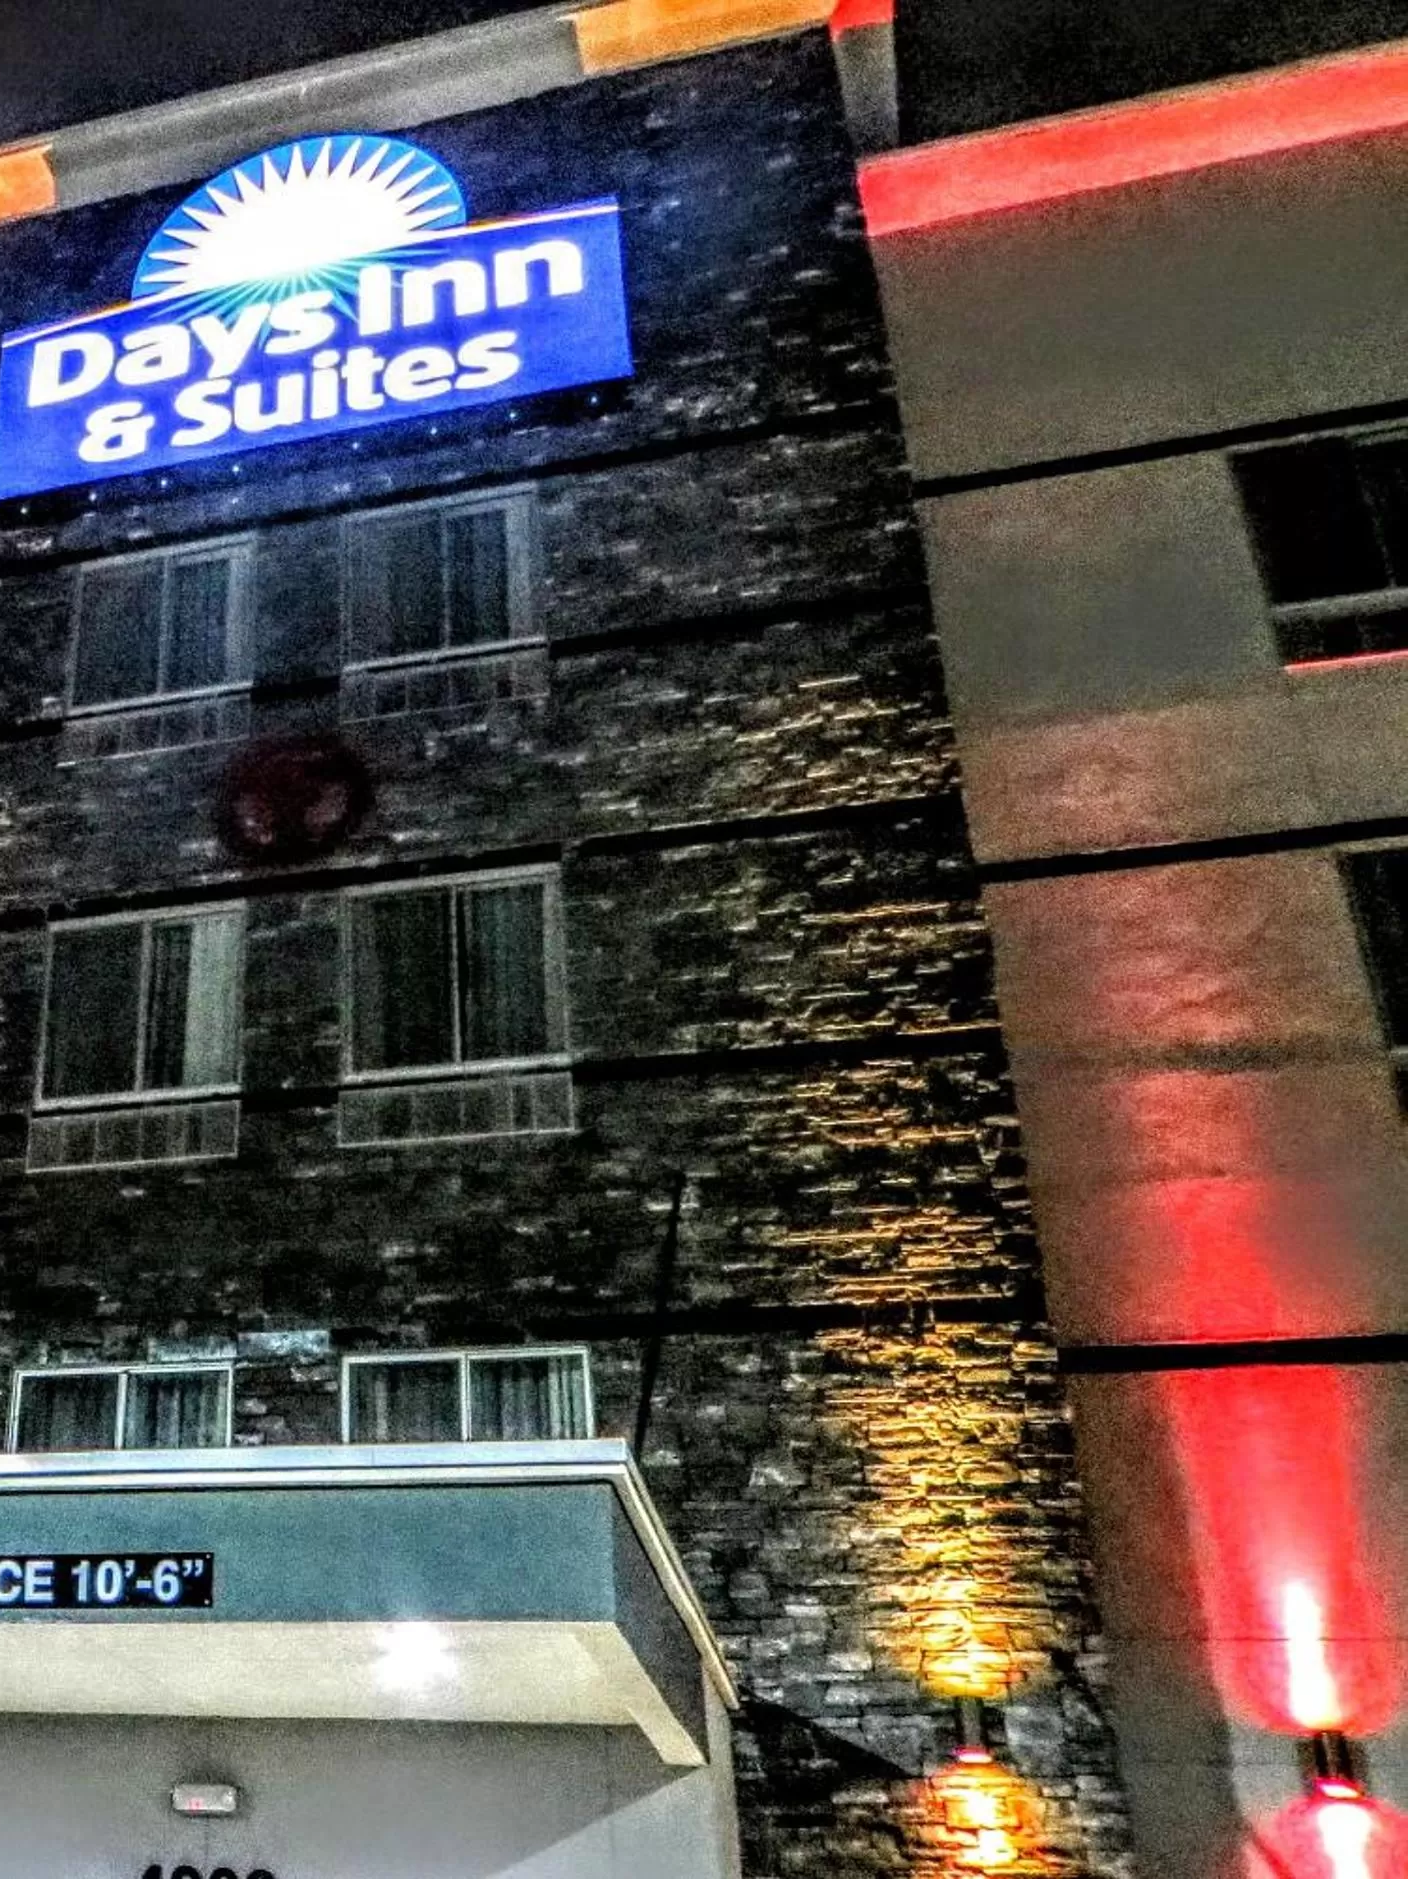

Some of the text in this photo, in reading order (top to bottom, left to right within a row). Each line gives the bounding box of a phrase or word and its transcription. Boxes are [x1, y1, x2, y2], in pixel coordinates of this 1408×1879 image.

[28, 238, 583, 407] Days Inn
[78, 331, 521, 463] & Suites
